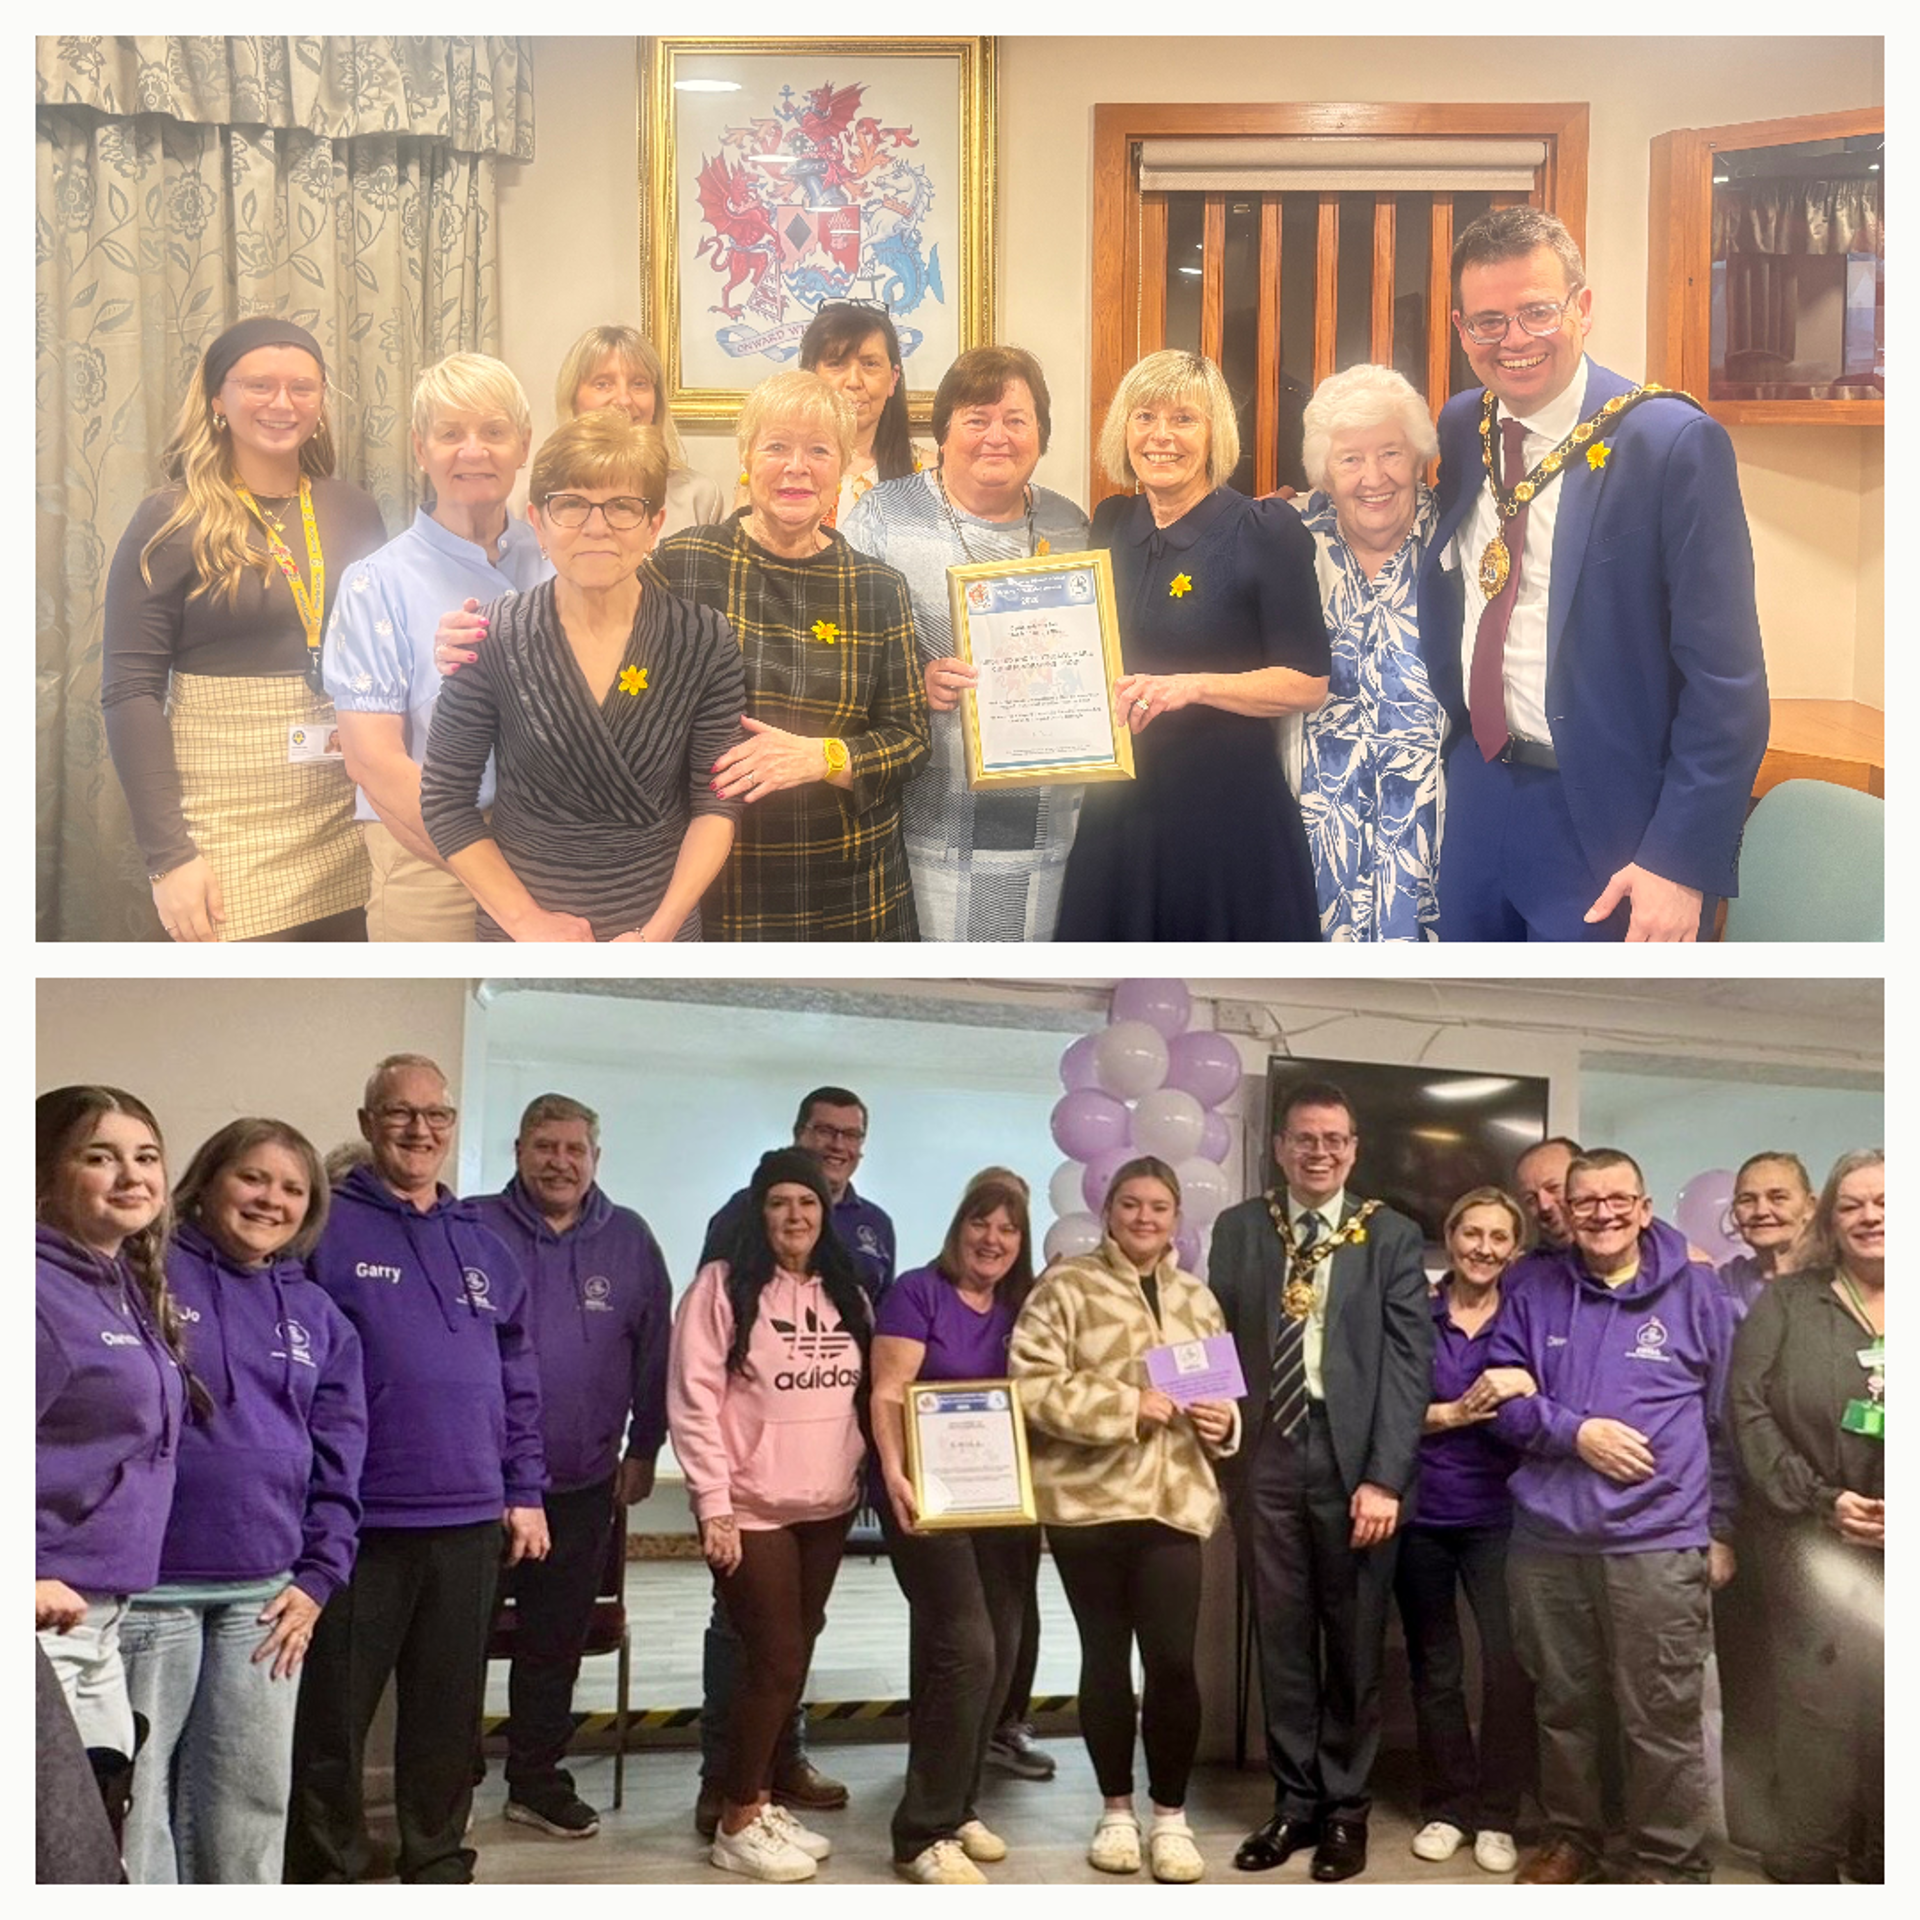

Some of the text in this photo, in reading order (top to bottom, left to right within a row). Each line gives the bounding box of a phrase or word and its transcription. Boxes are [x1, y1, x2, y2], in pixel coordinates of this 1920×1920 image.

[737, 329, 785, 353] ONWARD
[356, 1261, 401, 1284] Garry
[179, 1306, 201, 1322] Jo
[774, 1365, 861, 1391] adidas
